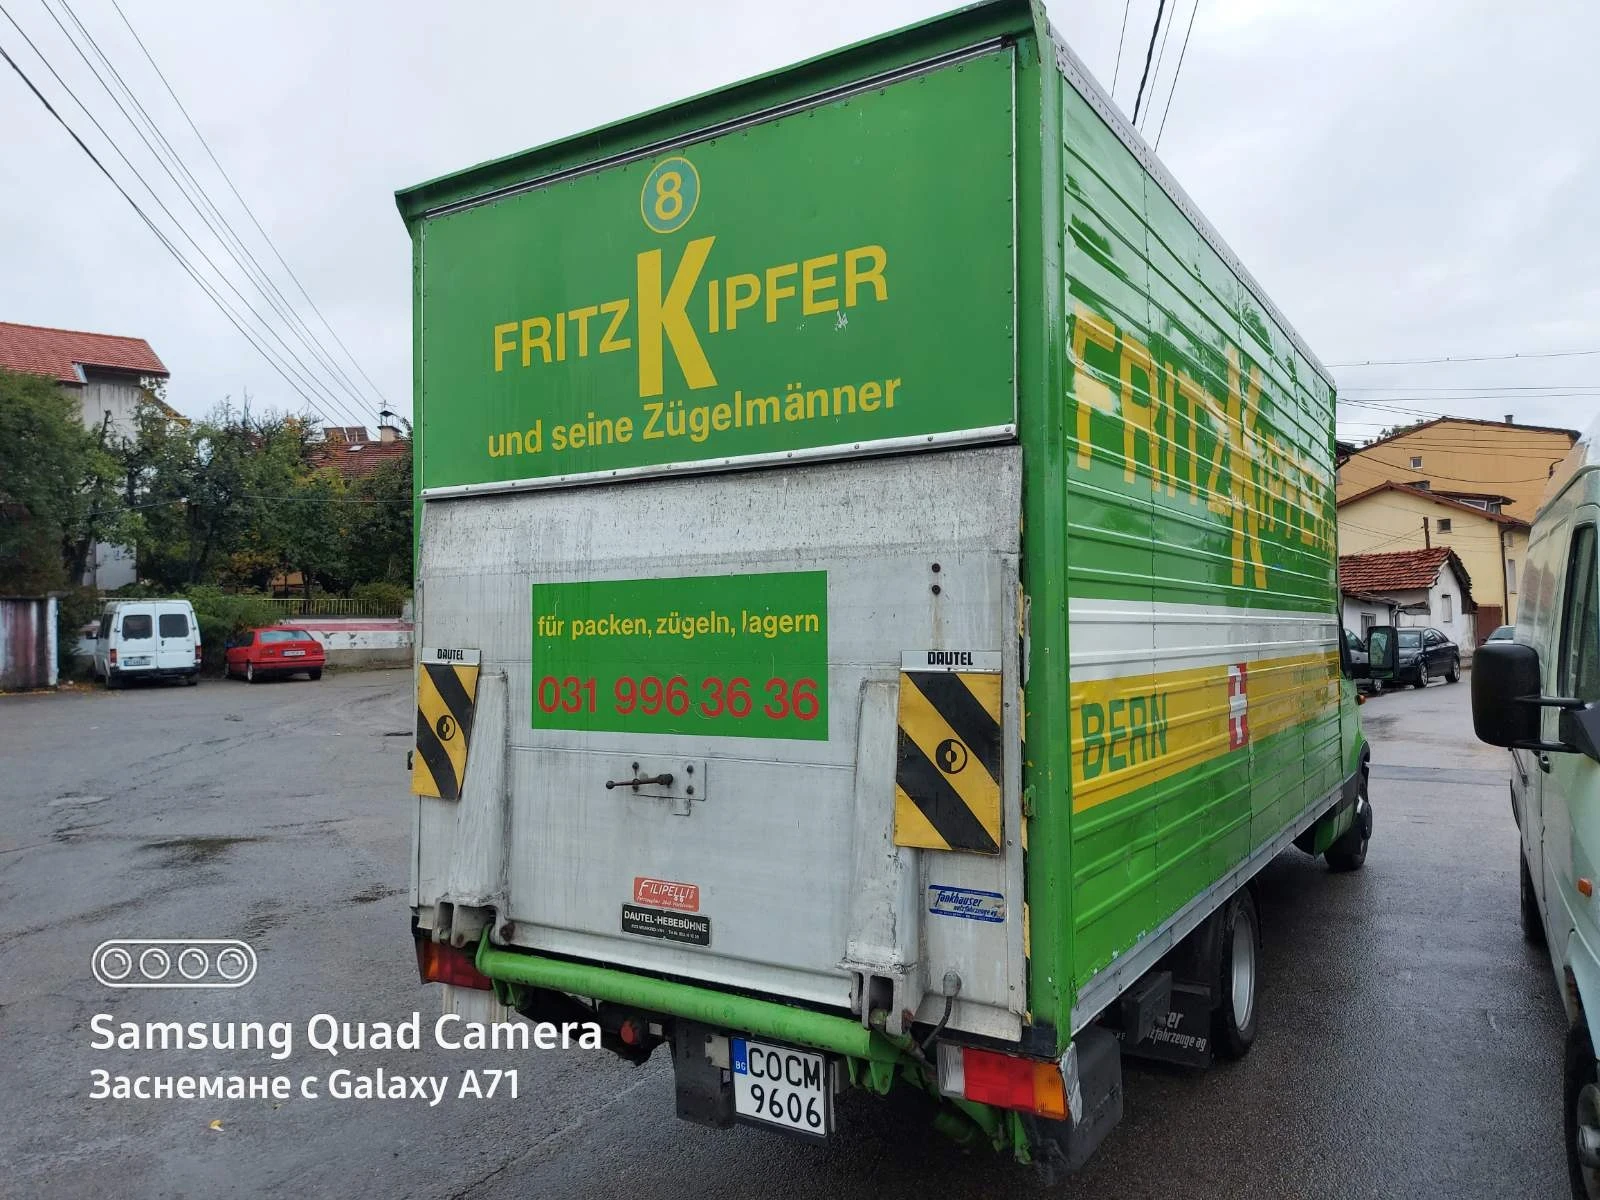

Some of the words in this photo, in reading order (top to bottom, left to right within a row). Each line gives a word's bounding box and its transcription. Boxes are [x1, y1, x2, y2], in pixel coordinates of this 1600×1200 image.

[653, 171, 684, 221] 8
[494, 298, 631, 373] FRITZ
[487, 419, 544, 458] und
[551, 410, 633, 452] seine
[642, 377, 902, 443] Zügelmänner
[537, 615, 565, 637] für
[572, 614, 653, 641] packen,
[656, 610, 737, 640] zügeln,
[742, 610, 820, 639] lagern
[437, 648, 464, 661] DAUTEL
[927, 651, 974, 666] DAUTEL
[537, 675, 598, 714] 031
[613, 675, 691, 717] 996
[699, 676, 753, 719] 36
[763, 676, 820, 721] 36
[1081, 691, 1168, 781] BERN
[623, 910, 708, 933] DAUTEL-HEBEBÜHNE
[735, 1060, 747, 1071] BG
[750, 1083, 822, 1128] 9606
